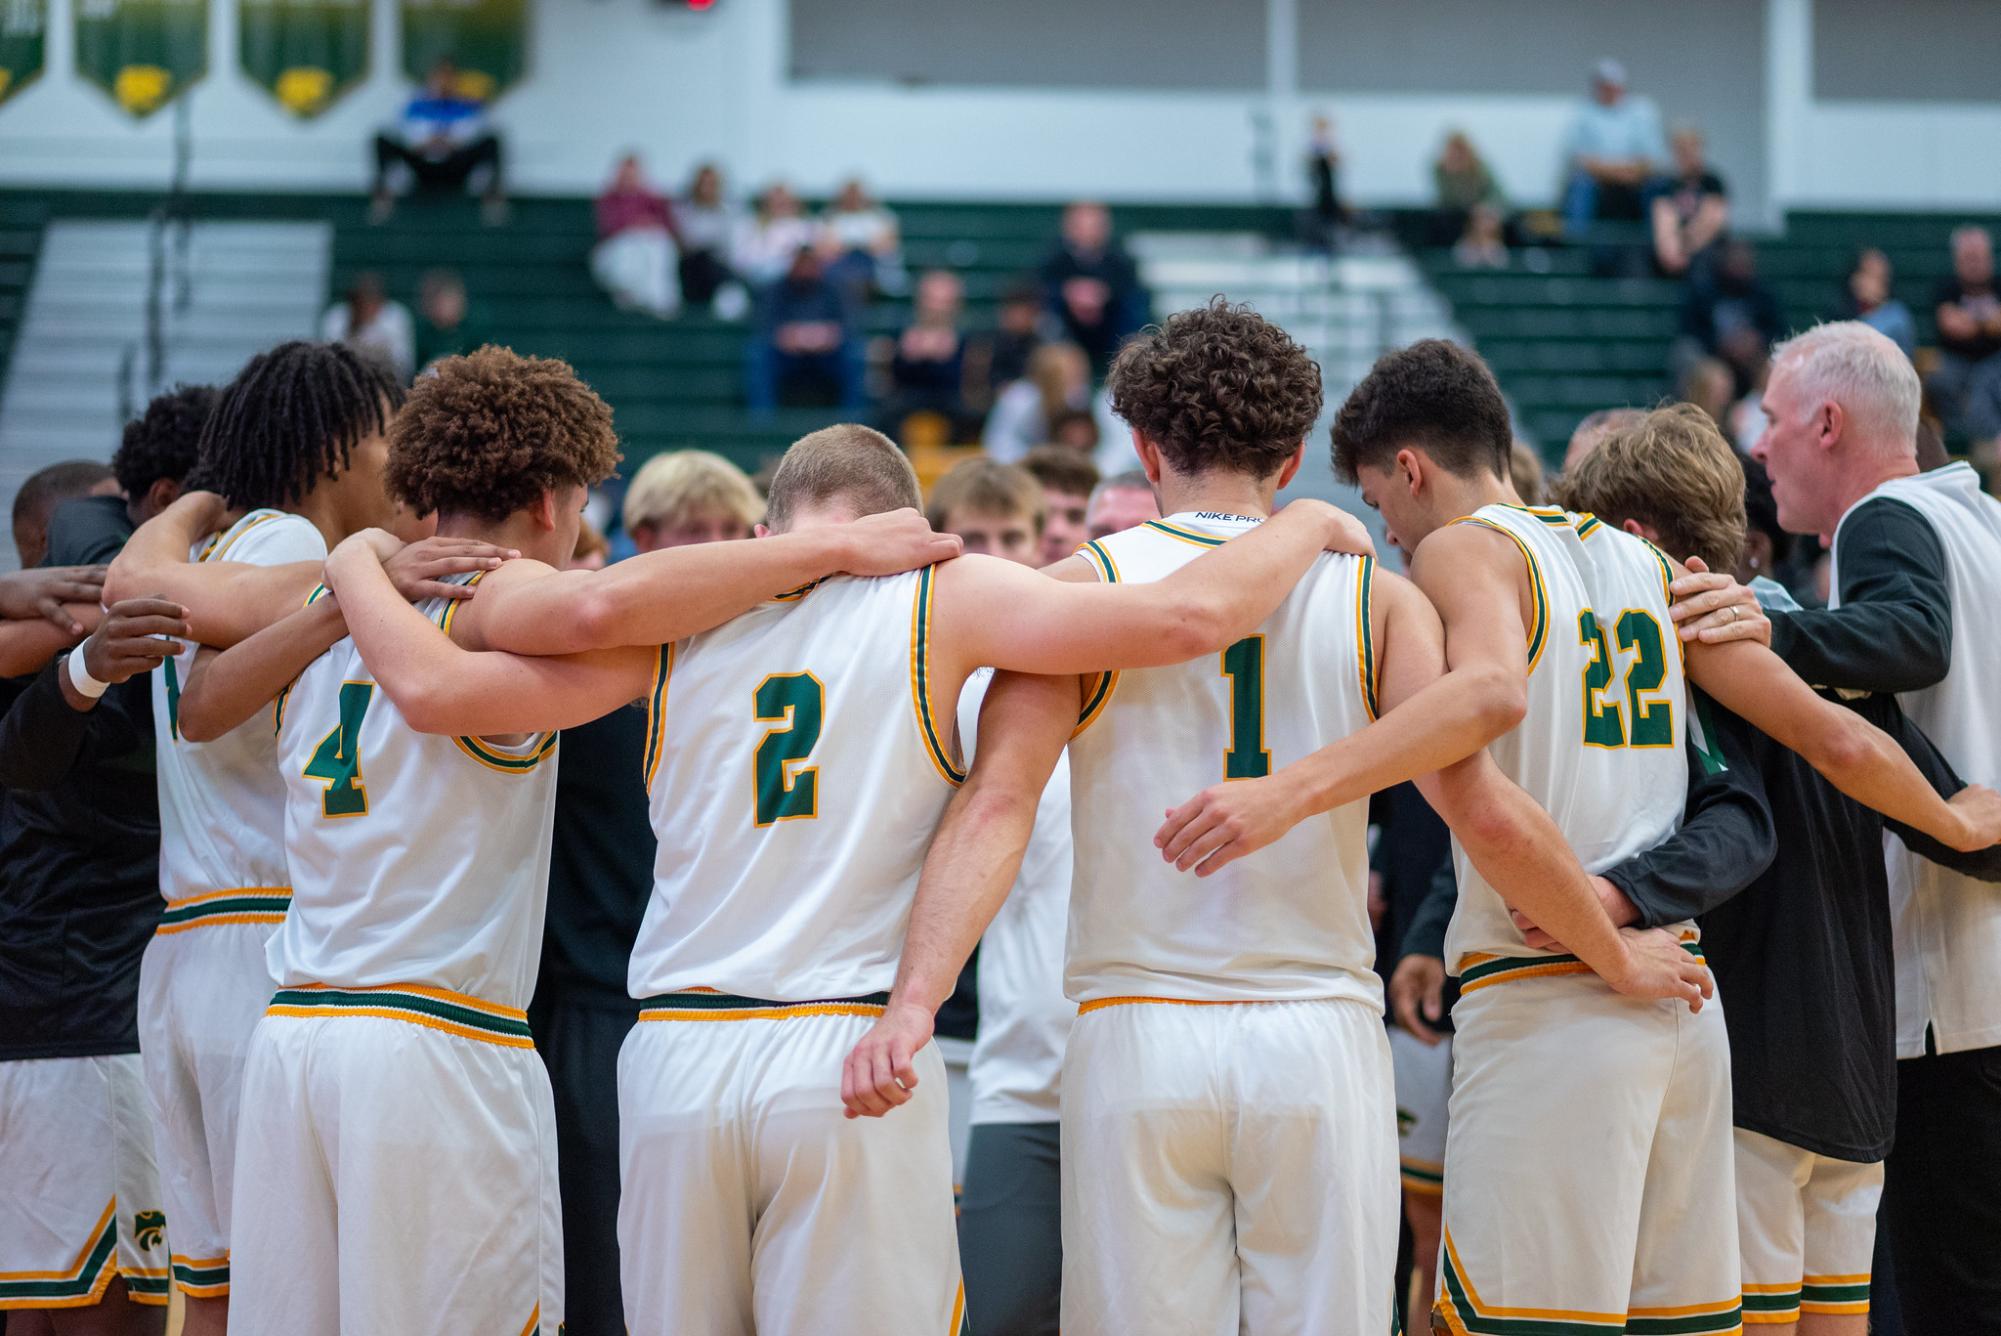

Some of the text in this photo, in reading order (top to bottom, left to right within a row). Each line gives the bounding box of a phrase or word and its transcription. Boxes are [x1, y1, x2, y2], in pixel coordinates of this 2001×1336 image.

[1195, 511, 1233, 521] NIKE
[753, 669, 825, 829] 2
[1220, 633, 1272, 783] 1
[1577, 608, 1674, 749] 22
[303, 680, 376, 819] 4
